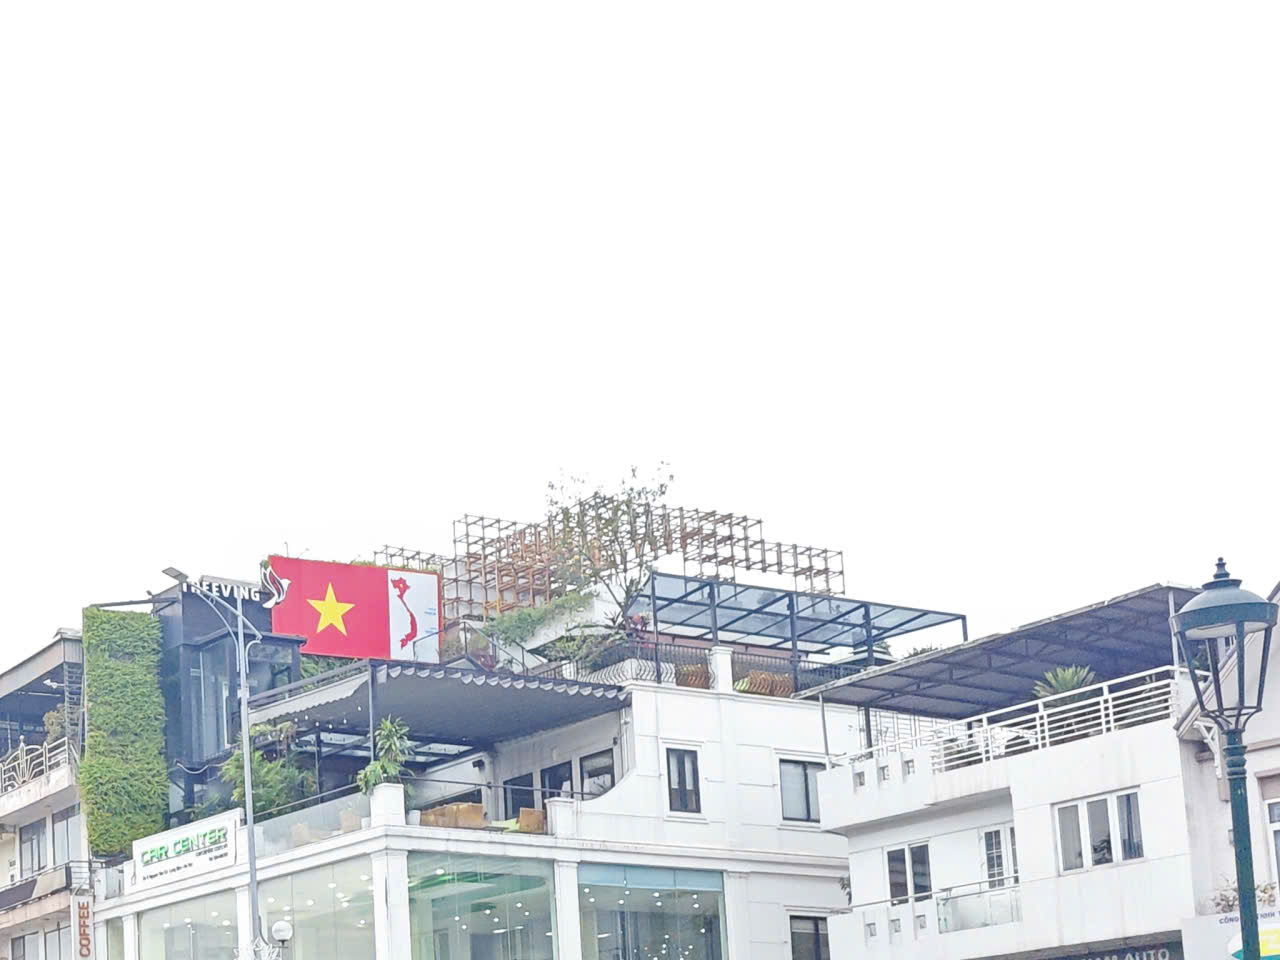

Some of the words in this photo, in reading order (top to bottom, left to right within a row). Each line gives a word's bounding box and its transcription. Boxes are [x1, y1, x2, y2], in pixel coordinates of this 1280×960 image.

[141, 845, 169, 866] CAR
[173, 826, 228, 855] CENTER
[78, 900, 92, 958] COFFEE
